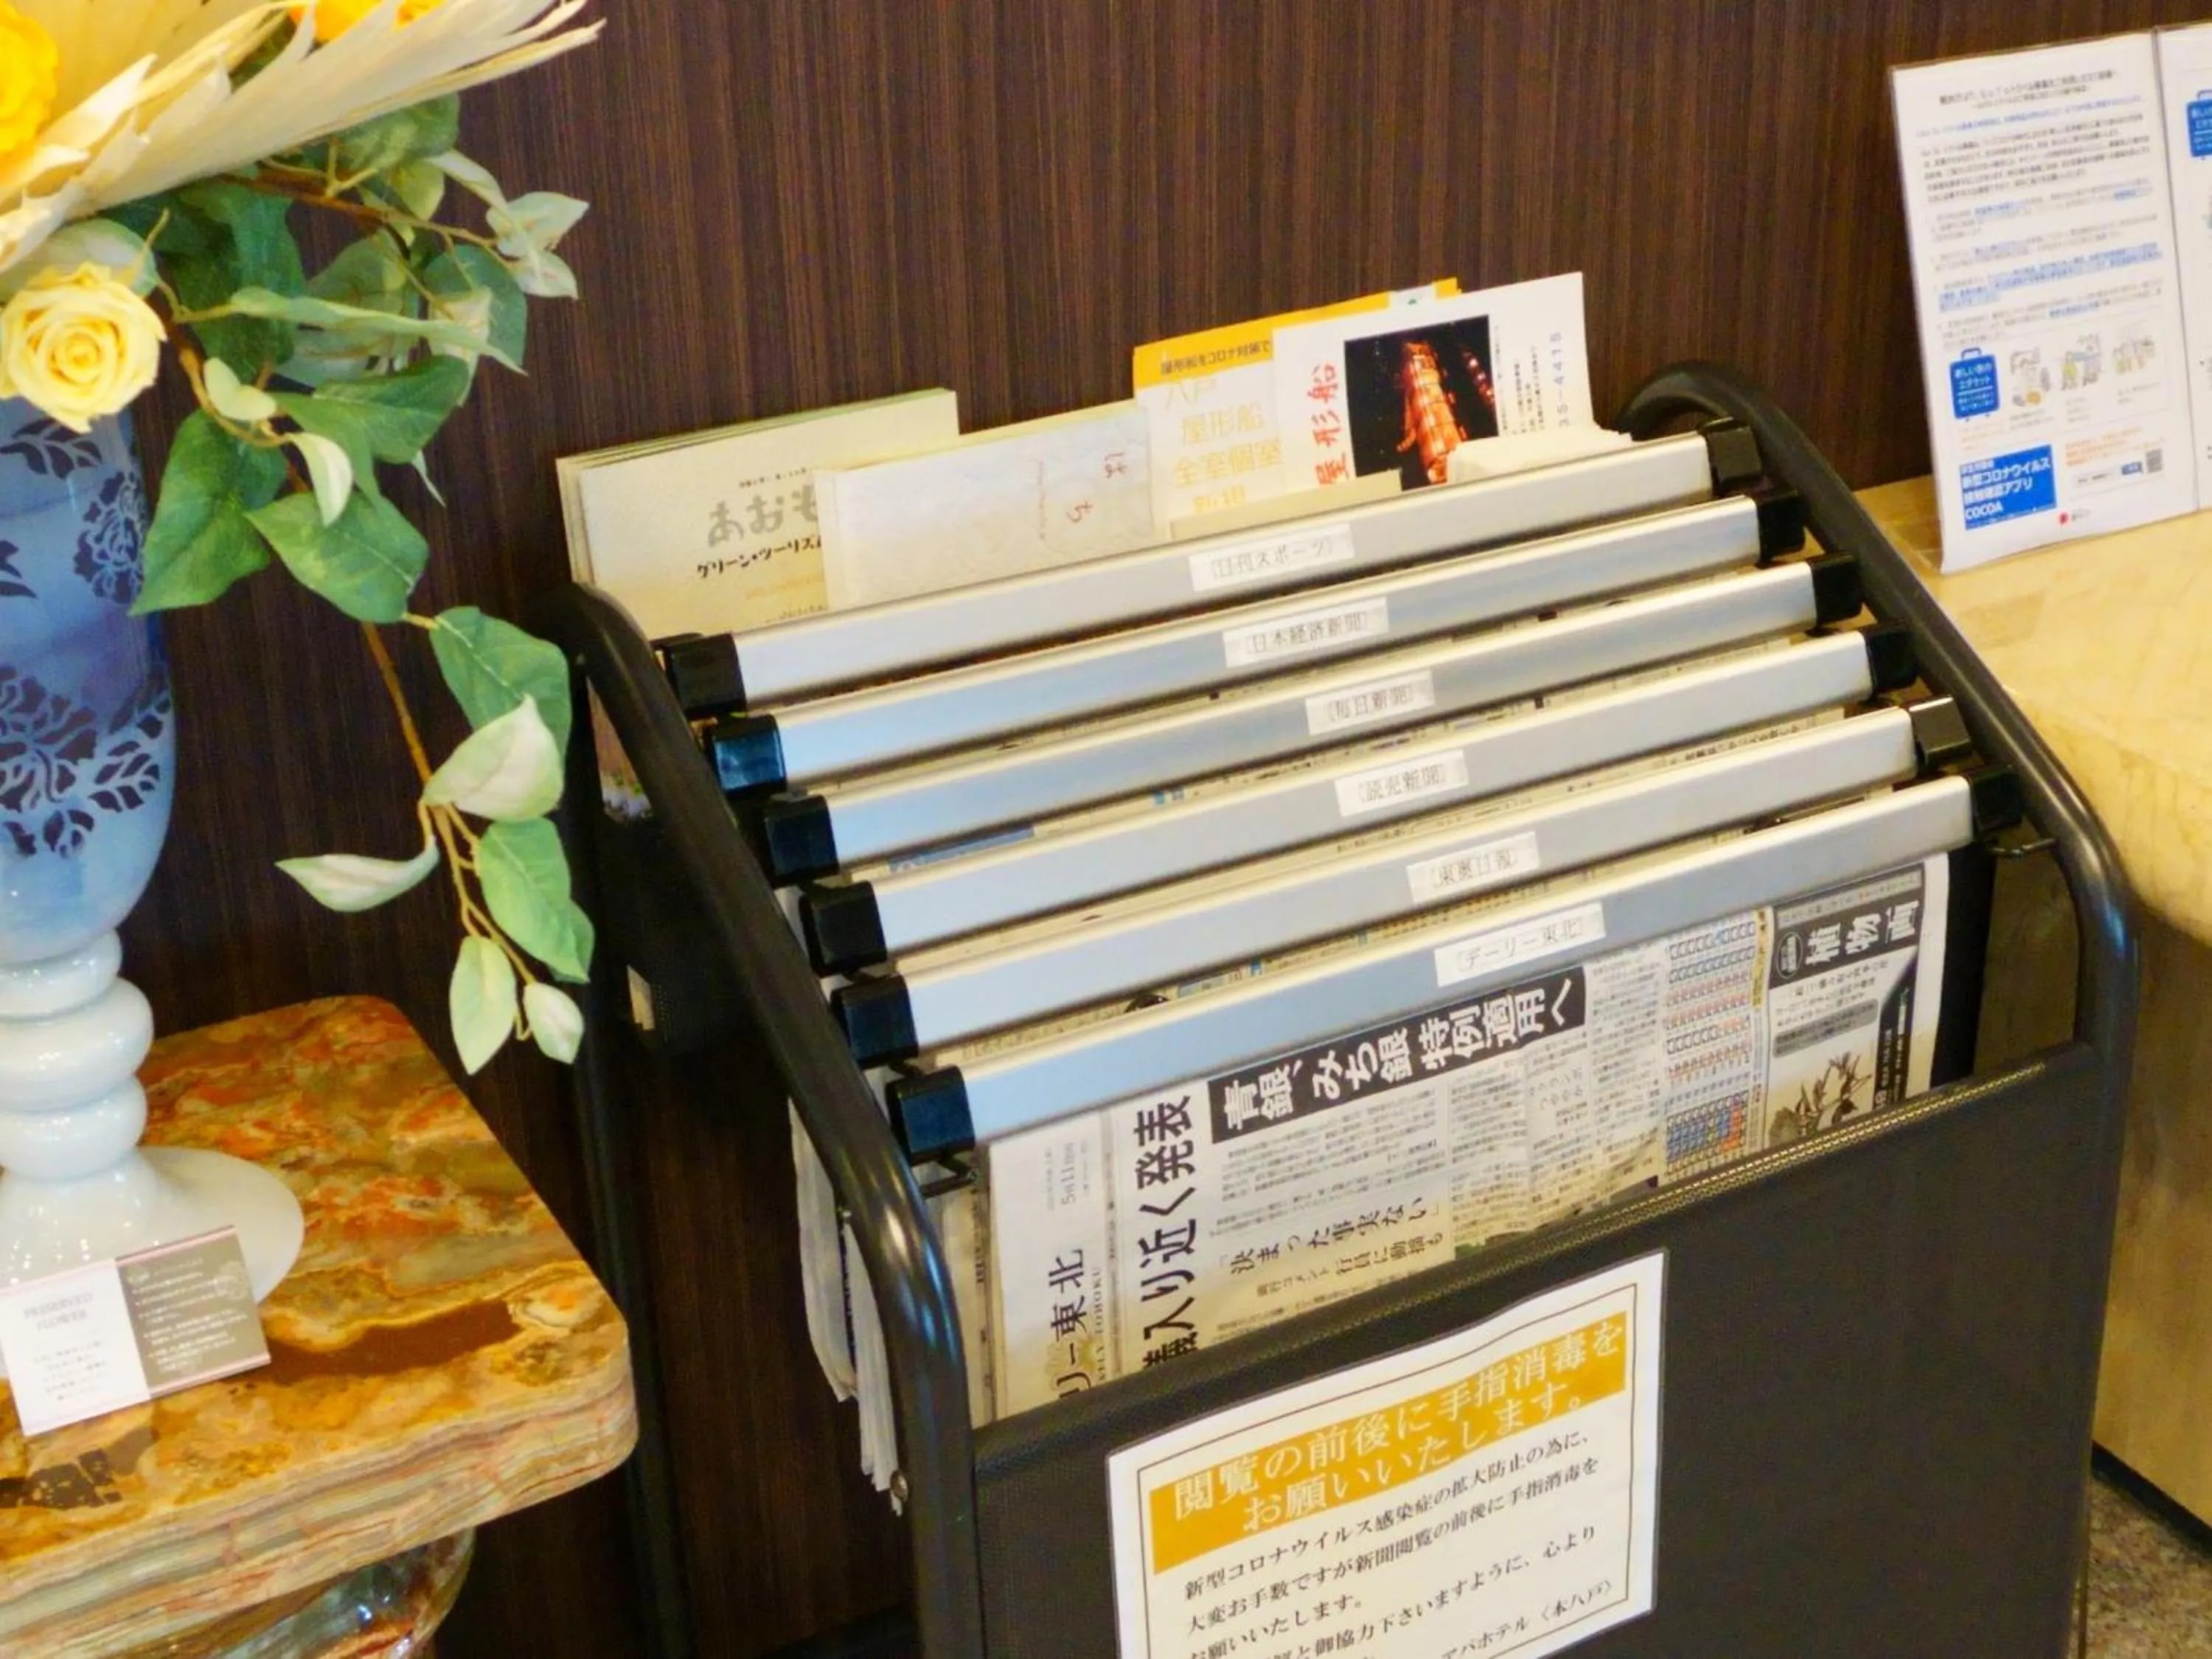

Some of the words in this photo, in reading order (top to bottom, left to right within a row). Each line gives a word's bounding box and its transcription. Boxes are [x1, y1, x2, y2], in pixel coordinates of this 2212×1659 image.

[1307, 362, 1349, 484] 屋形船
[1964, 500, 2003, 520] COCOA
[1418, 978, 1572, 1069] 特例適用へ
[1174, 1321, 1622, 1521] 閲覧の前後に手指消毒を
[1242, 1381, 1582, 1531] お願いいたします。
[1188, 1457, 1599, 1635] 大変お手数ですが新聞閲覧の前後に手指消毒を
